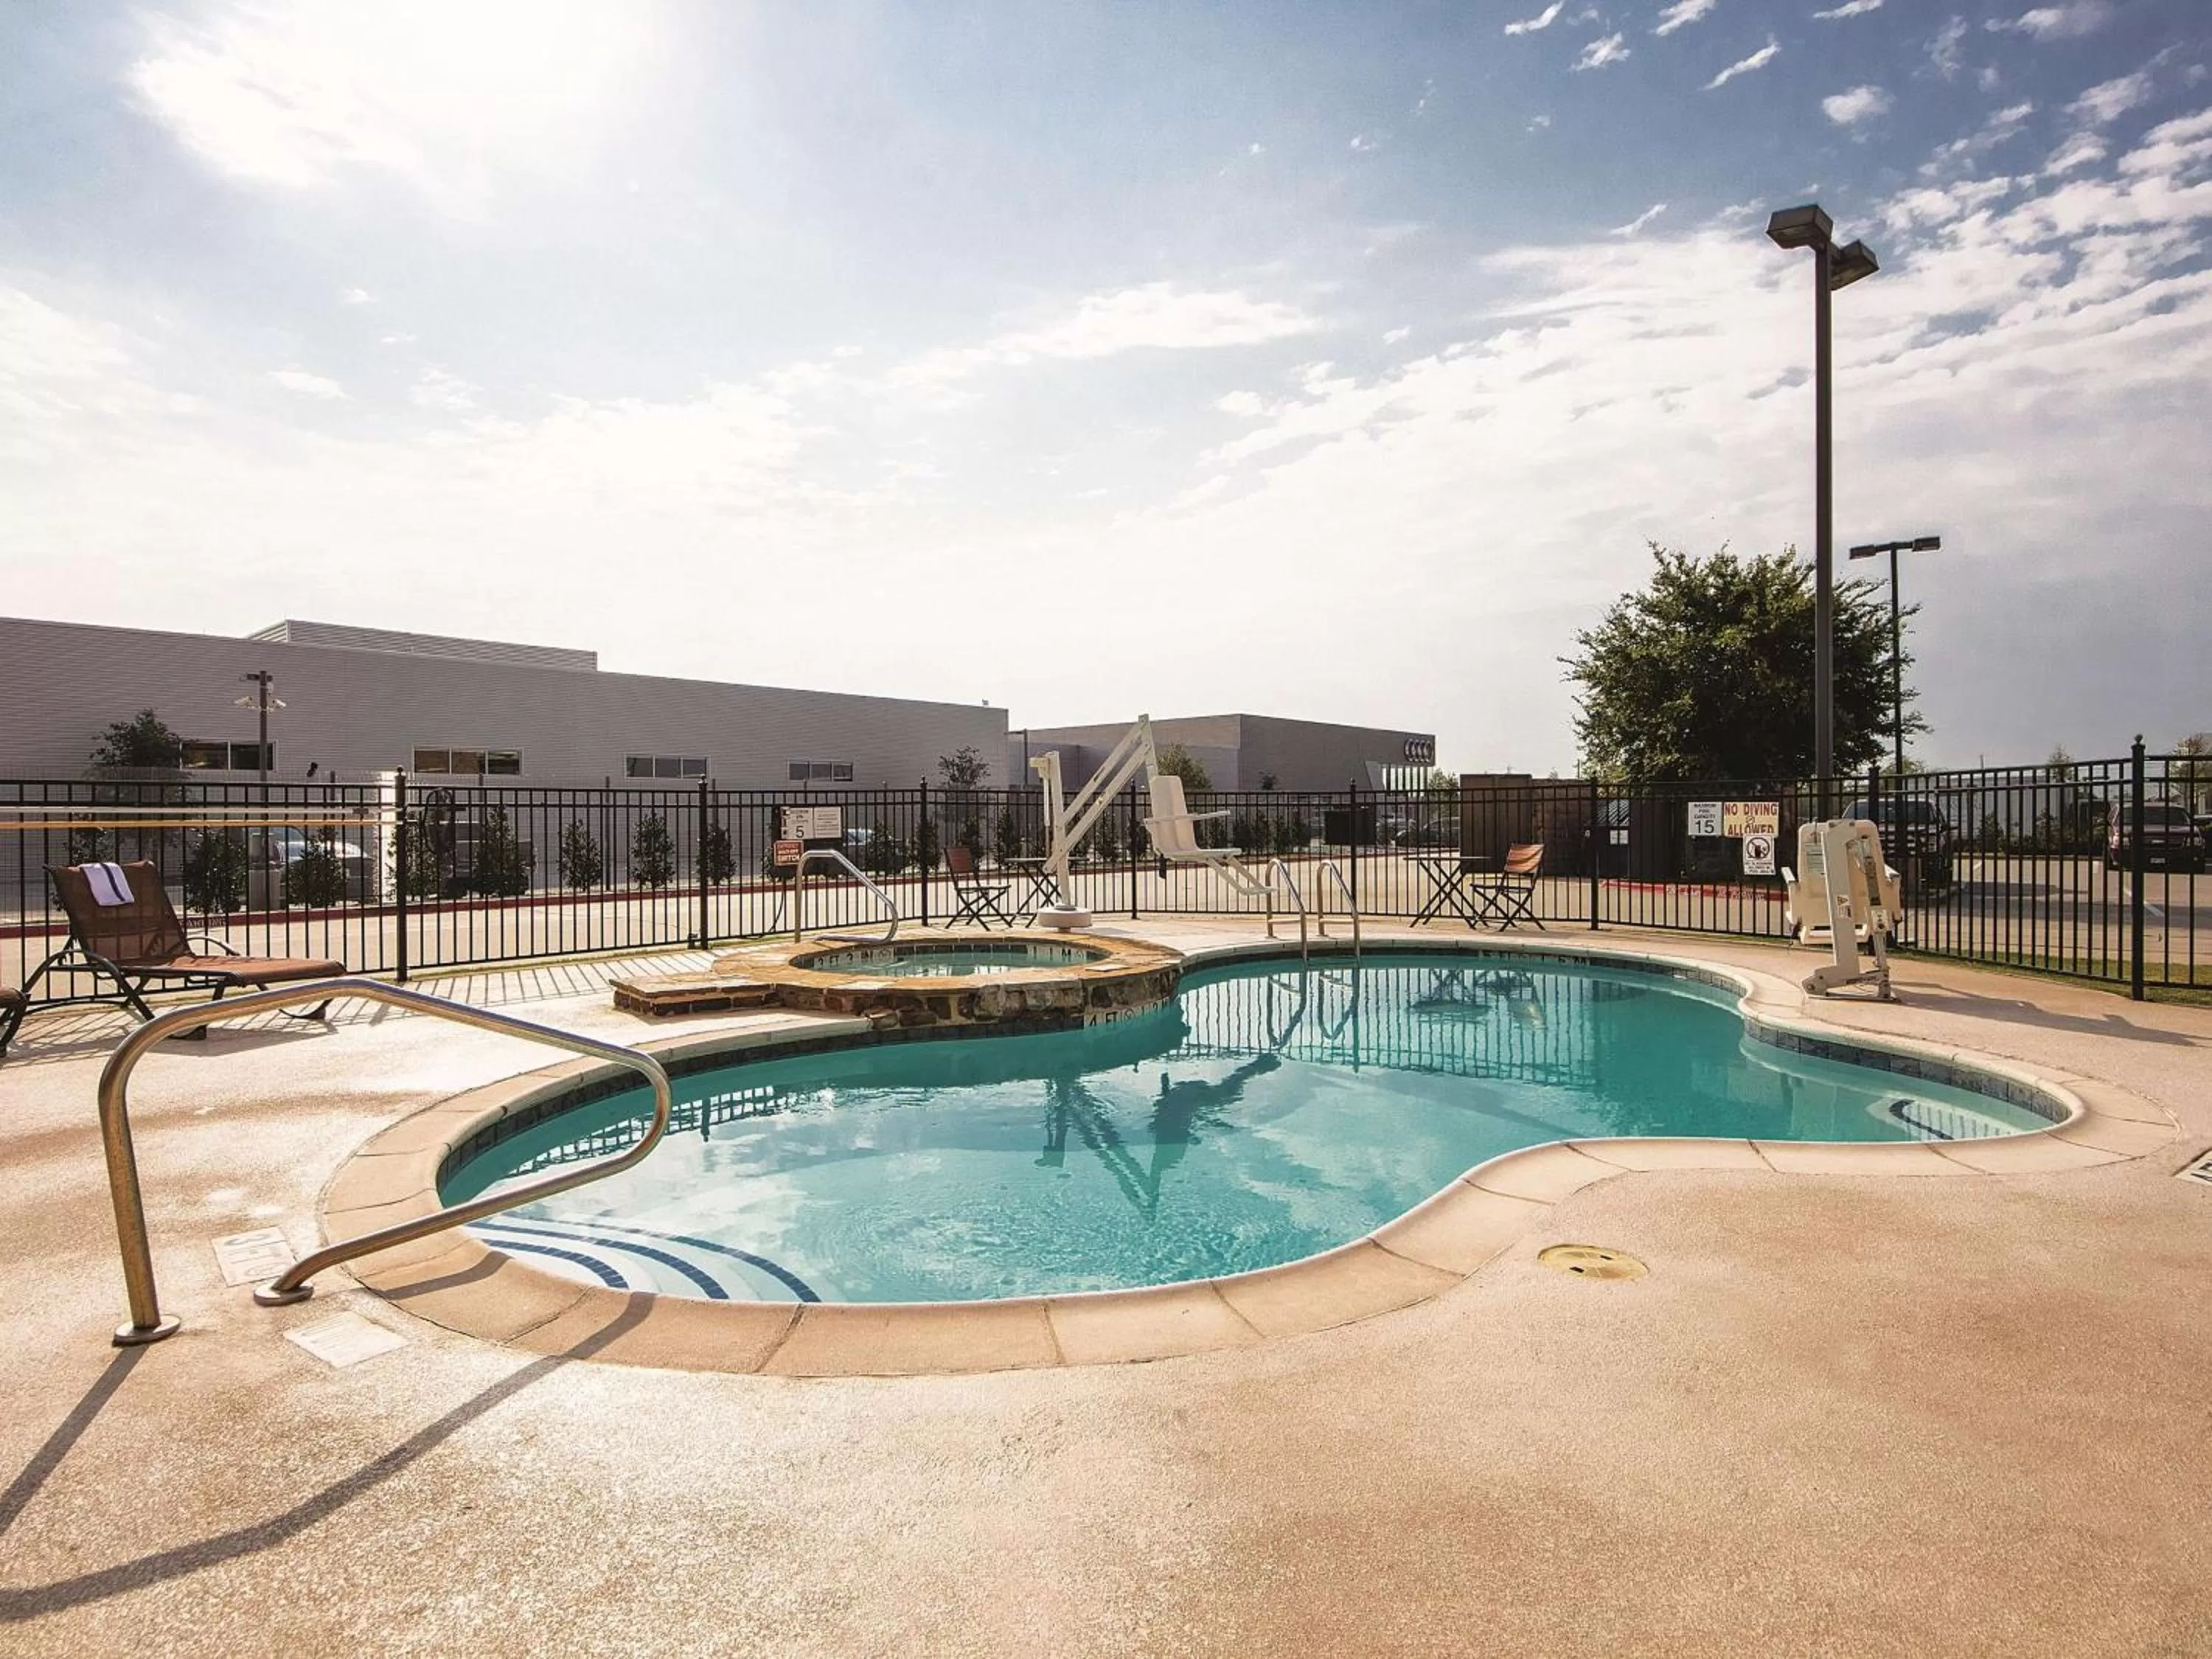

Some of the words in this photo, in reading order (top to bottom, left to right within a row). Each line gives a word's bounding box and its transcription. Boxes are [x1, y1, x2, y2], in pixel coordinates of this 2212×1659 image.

[1725, 803, 1738, 815] NO
[1744, 803, 1778, 815] DIVING
[796, 825, 804, 838] 5
[1695, 819, 1715, 834] 15
[1728, 824, 1775, 836] ALLOWED
